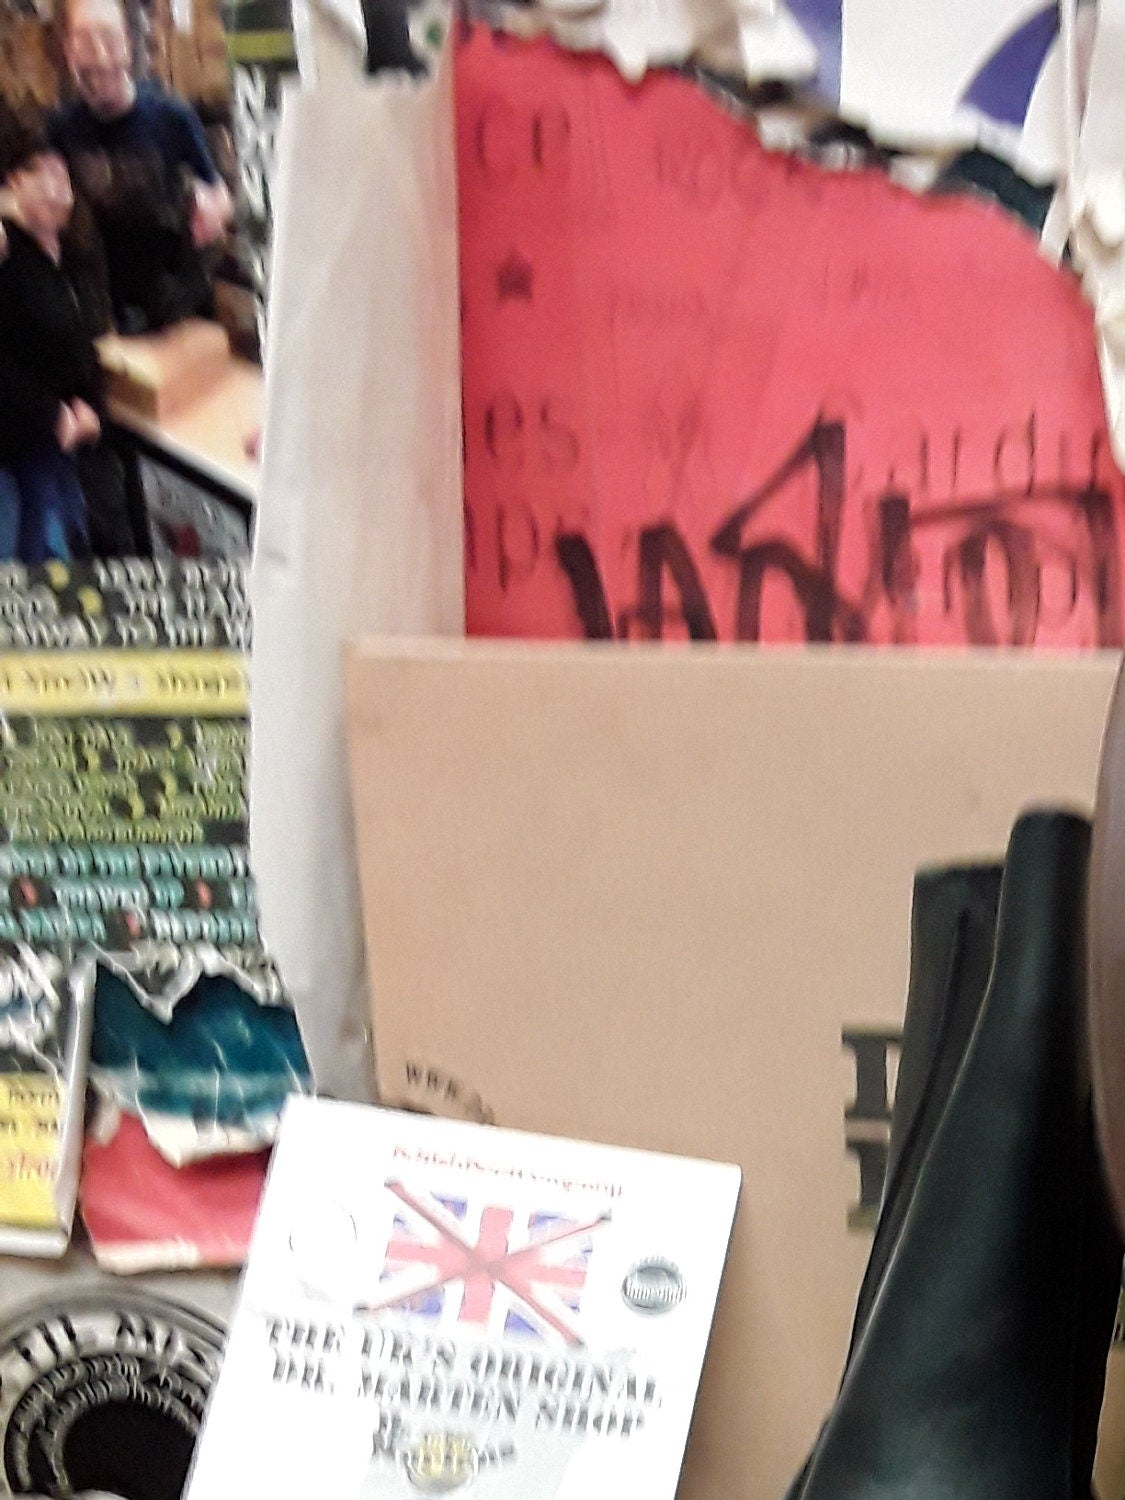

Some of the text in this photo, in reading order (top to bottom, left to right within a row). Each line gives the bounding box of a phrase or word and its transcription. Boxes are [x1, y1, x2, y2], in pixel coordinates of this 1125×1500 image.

[266, 1315, 345, 1354] THE
[470, 1347, 662, 1408] ORIGINAL
[534, 1396, 646, 1438] SHOP
